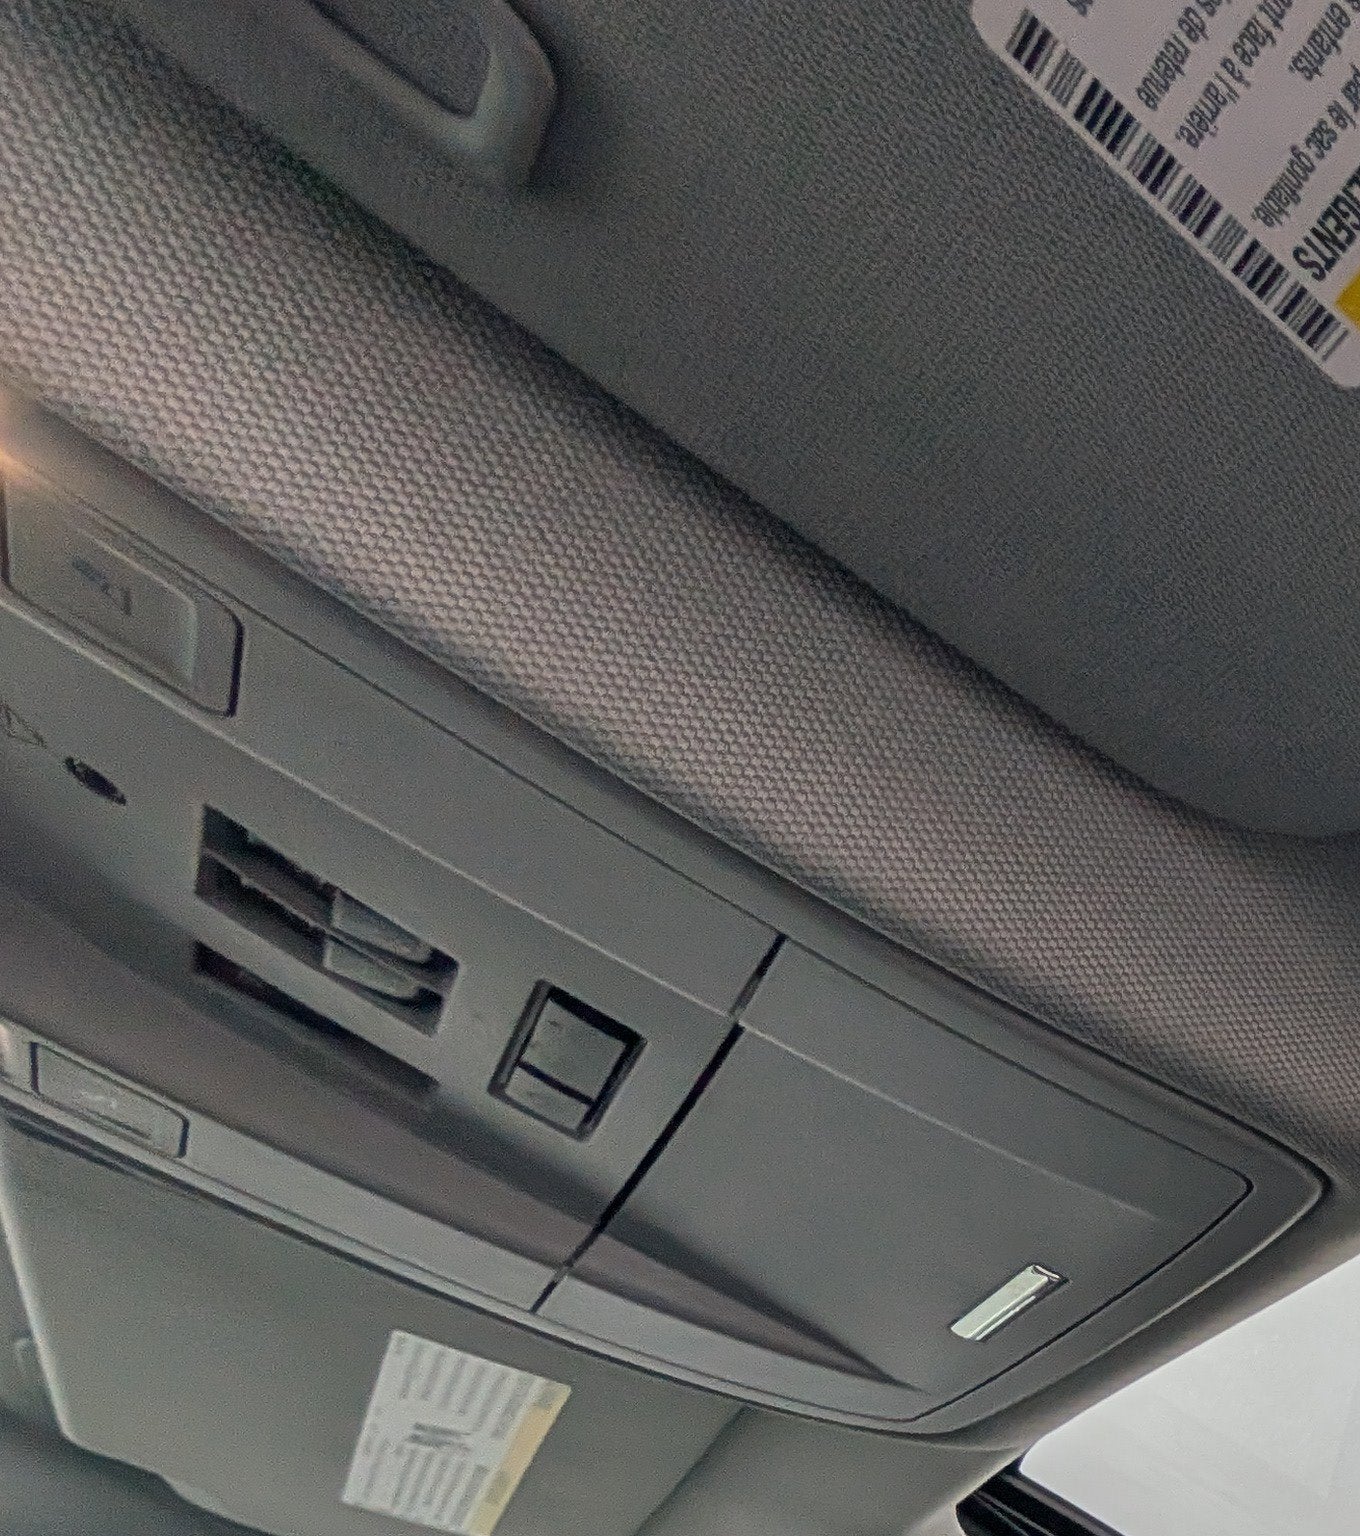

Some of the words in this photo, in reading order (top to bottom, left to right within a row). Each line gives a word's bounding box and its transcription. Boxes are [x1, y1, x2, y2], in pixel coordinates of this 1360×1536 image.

[1178, 6, 1209, 43] de
[1233, 15, 1276, 67] face
[1289, 2, 1350, 80] enfants.
[1135, 33, 1189, 111] retenue
[1220, 56, 1250, 88] à
[1306, 117, 1337, 159] sac
[1328, 100, 1357, 130] le
[1251, 144, 1315, 228] gonflable.
